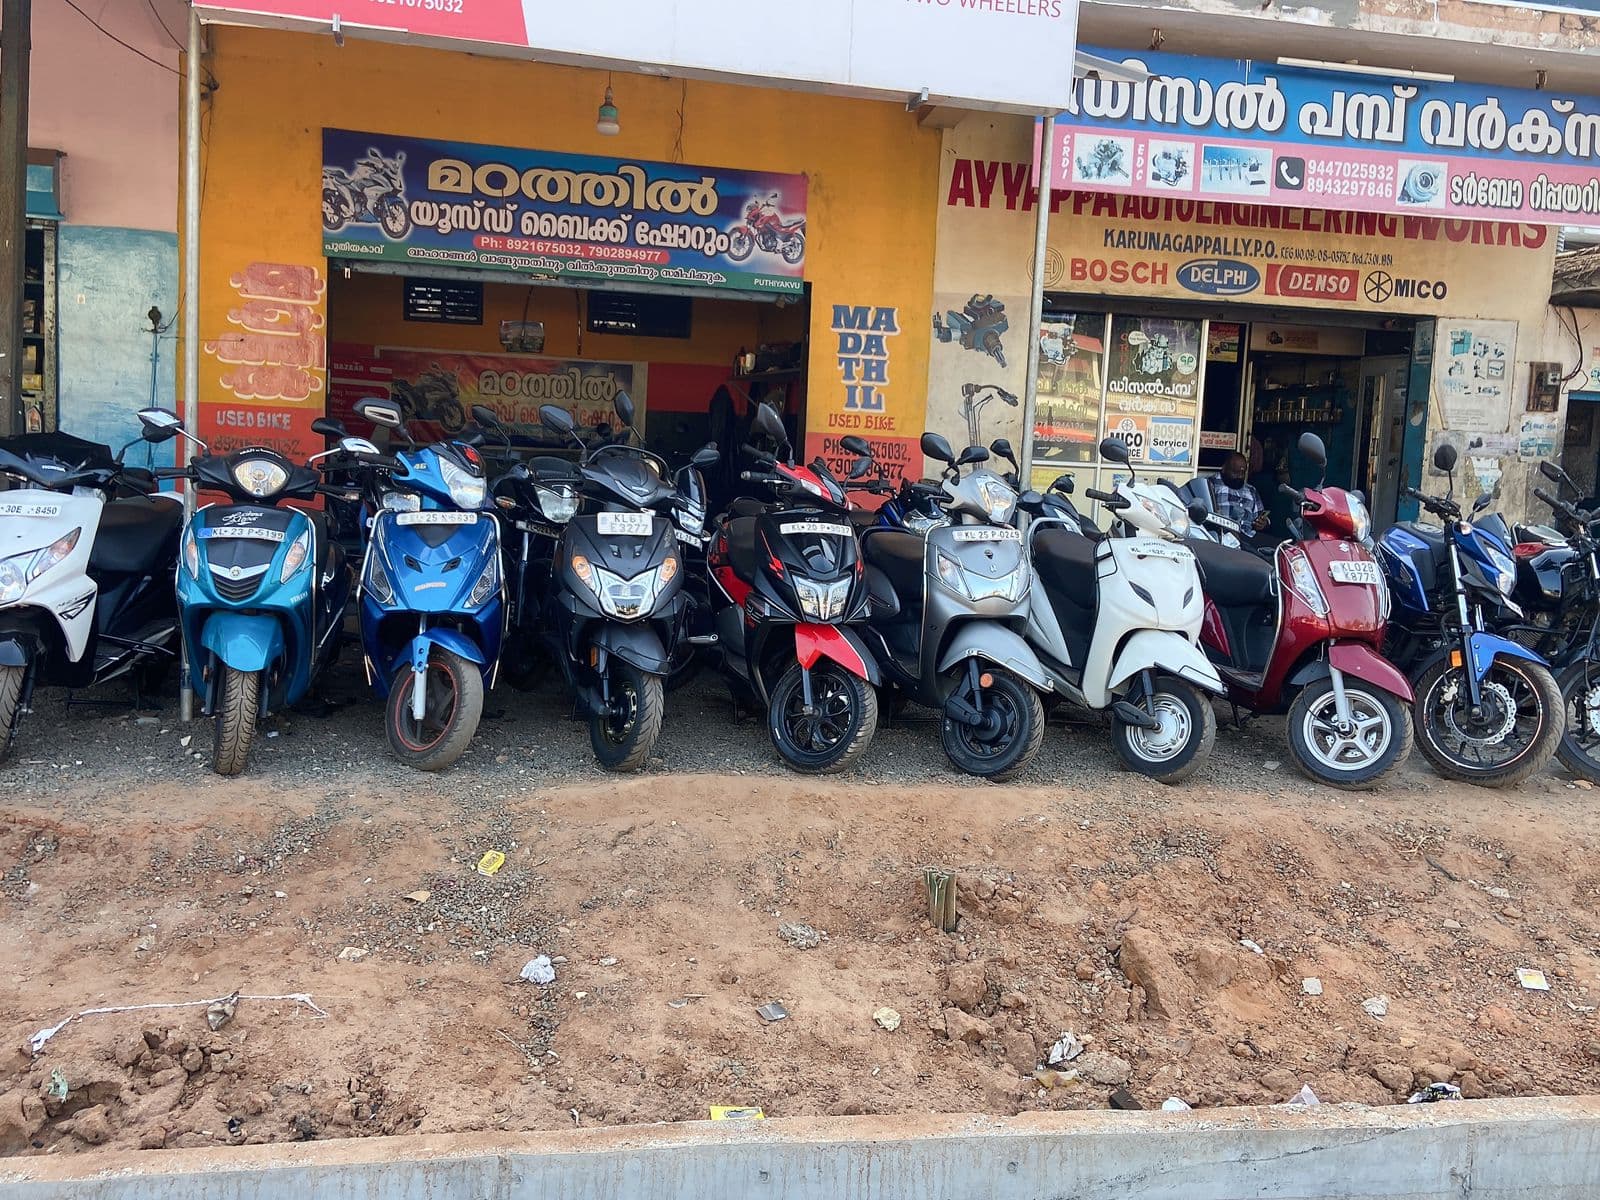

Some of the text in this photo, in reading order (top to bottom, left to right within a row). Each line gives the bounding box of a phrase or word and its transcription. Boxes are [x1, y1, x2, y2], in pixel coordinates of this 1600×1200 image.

[1060, 133, 1071, 180] CRDI
[1135, 143, 1146, 181] EDC
[1307, 159, 1395, 181] 9447025932
[428, 158, 719, 217] മഠത്തിൽ
[1307, 176, 1393, 199] 8943297846
[1530, 173, 1600, 214] റിപ്പയറി
[480, 236, 662, 261] Ph: 8921675032, 7902894977
[520, 210, 633, 247] ബൈക്ക്
[635, 220, 730, 257] ഷോറും
[1070, 258, 1448, 300] BOSCH DELPHI DENSO MICO
[478, 366, 617, 401] മഠത്തിൽ
[215, 410, 292, 431] USED BIKE
[828, 413, 896, 431] USED BIKE
[1109, 432, 1143, 447] MICO
[1152, 438, 1188, 448] Service
